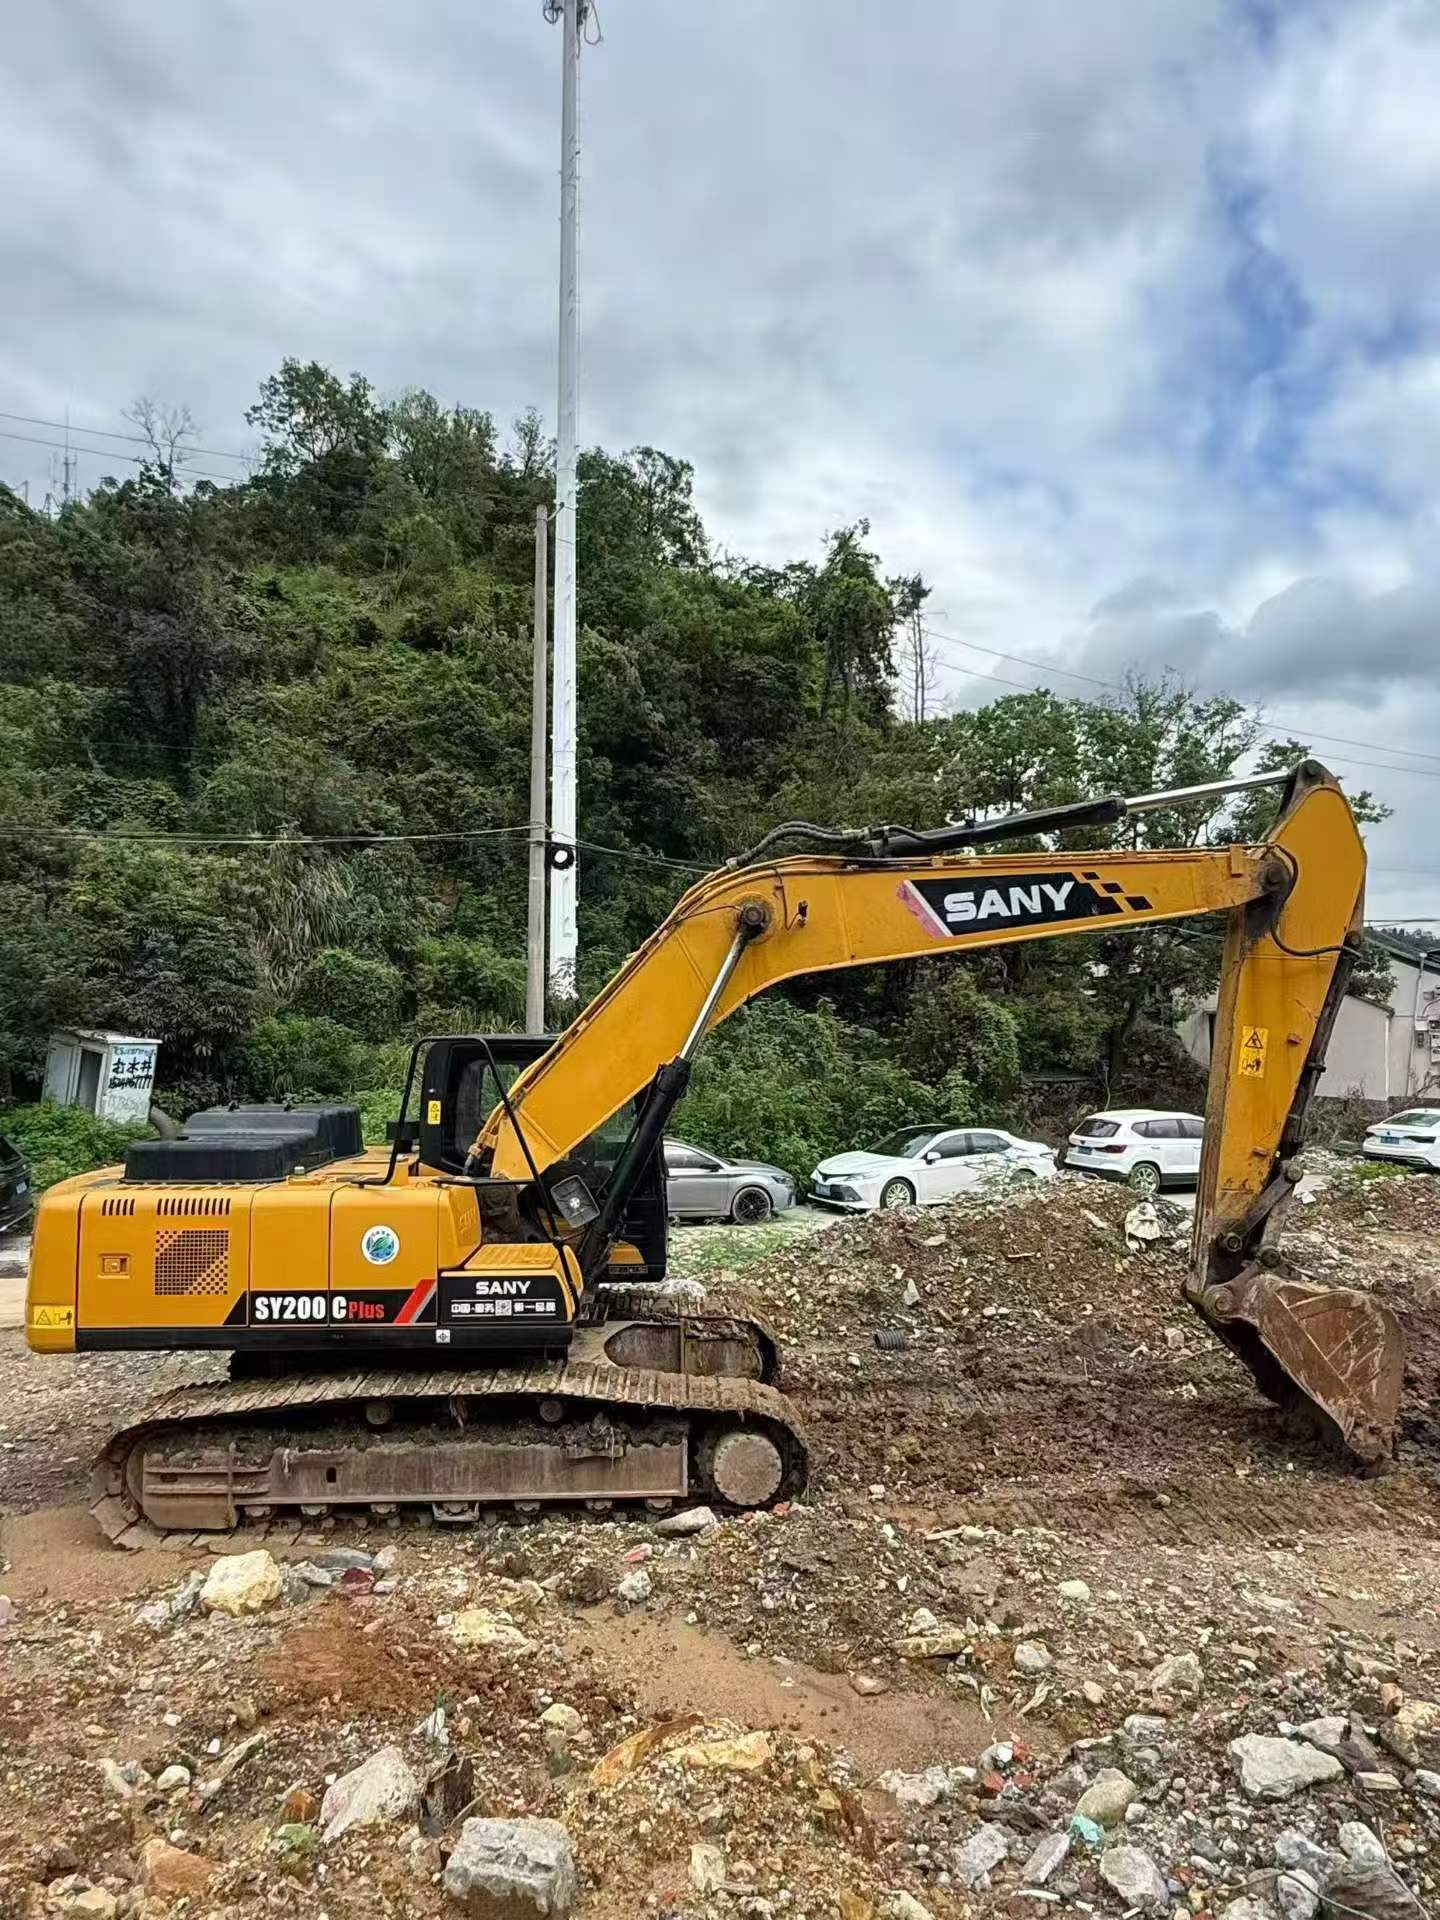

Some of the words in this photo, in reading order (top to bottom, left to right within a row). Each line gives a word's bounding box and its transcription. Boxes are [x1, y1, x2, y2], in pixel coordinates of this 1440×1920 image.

[944, 881, 1075, 922] SANY
[475, 1281, 531, 1295] SANY
[255, 1296, 326, 1320] SY200
